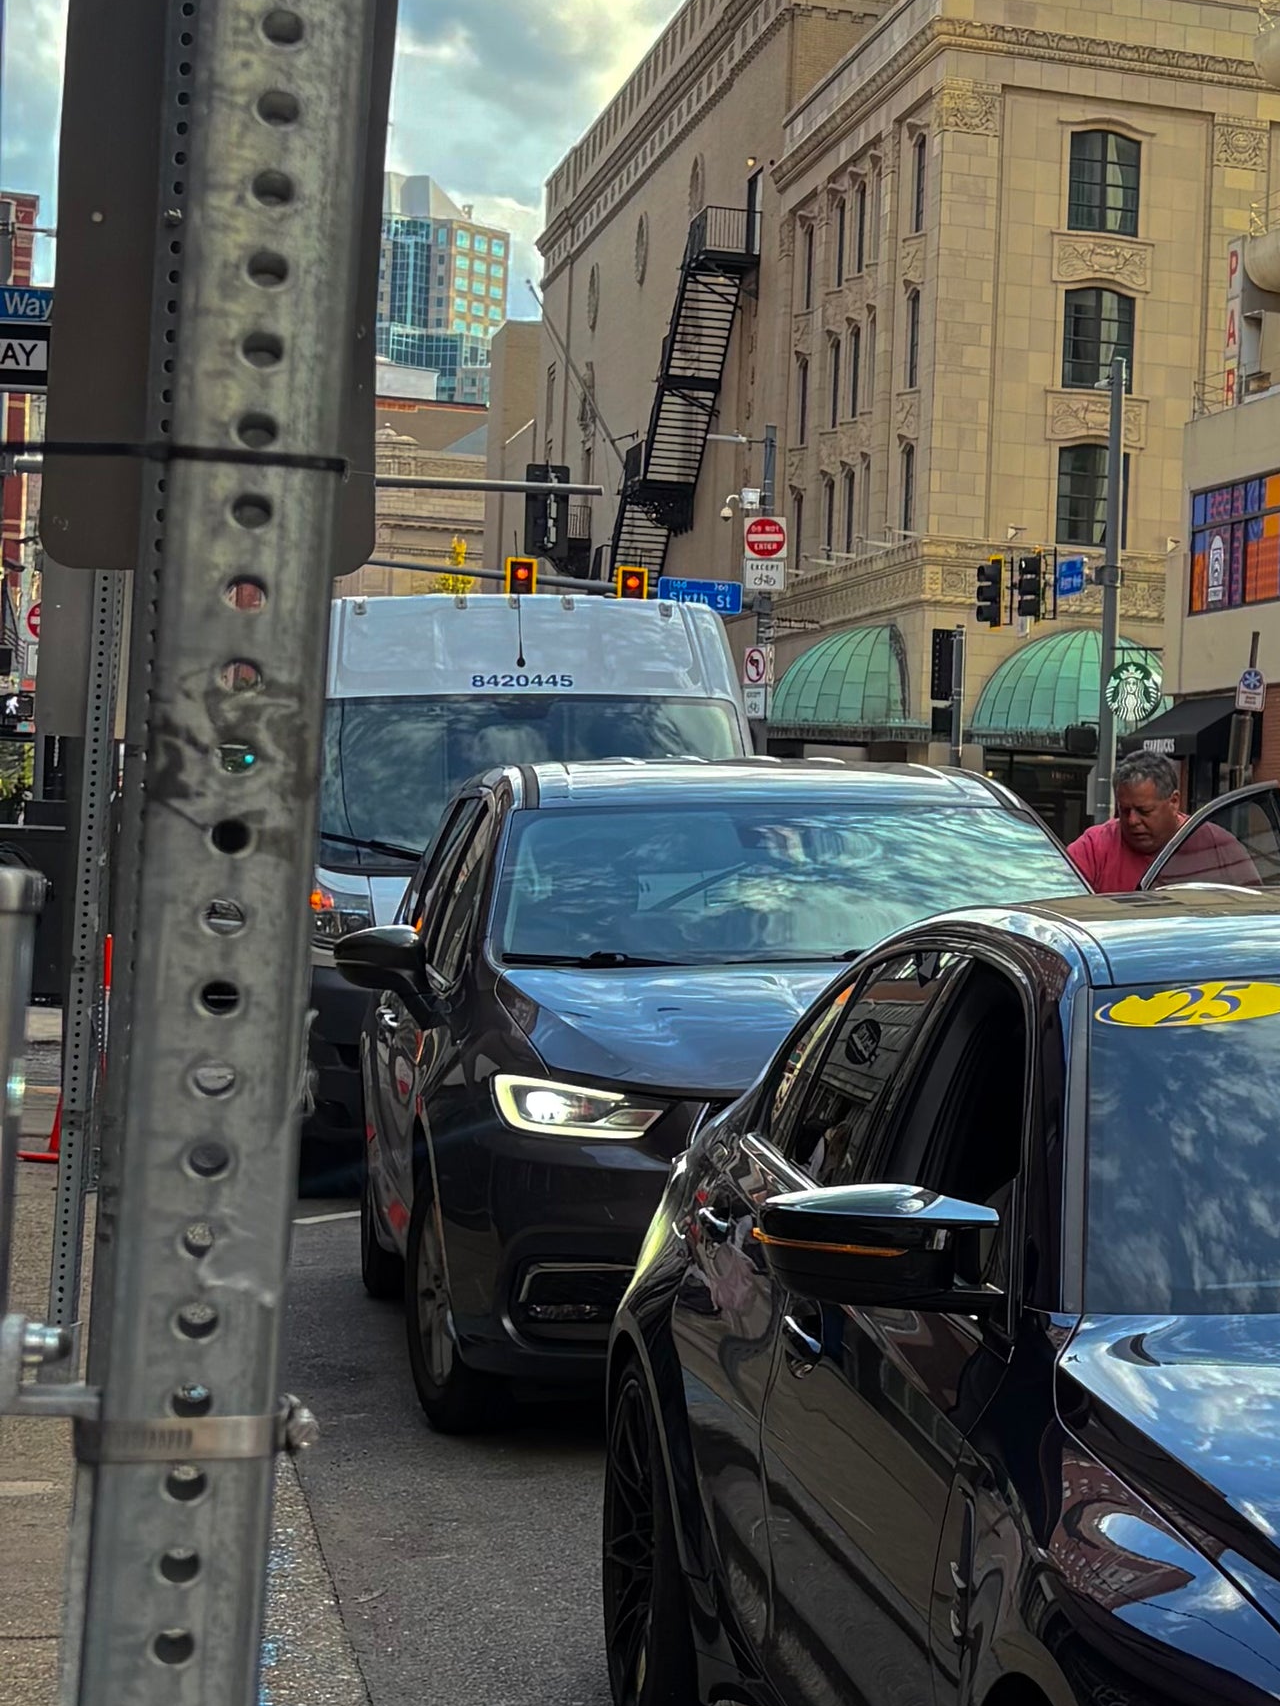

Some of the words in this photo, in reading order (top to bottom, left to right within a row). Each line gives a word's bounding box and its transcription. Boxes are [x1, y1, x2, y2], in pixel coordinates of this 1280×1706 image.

[5, 292, 53, 320] Way
[0, 342, 38, 366] AY
[716, 595, 731, 608] St
[471, 674, 574, 688] 8420445
[1154, 983, 1252, 1025] 25
